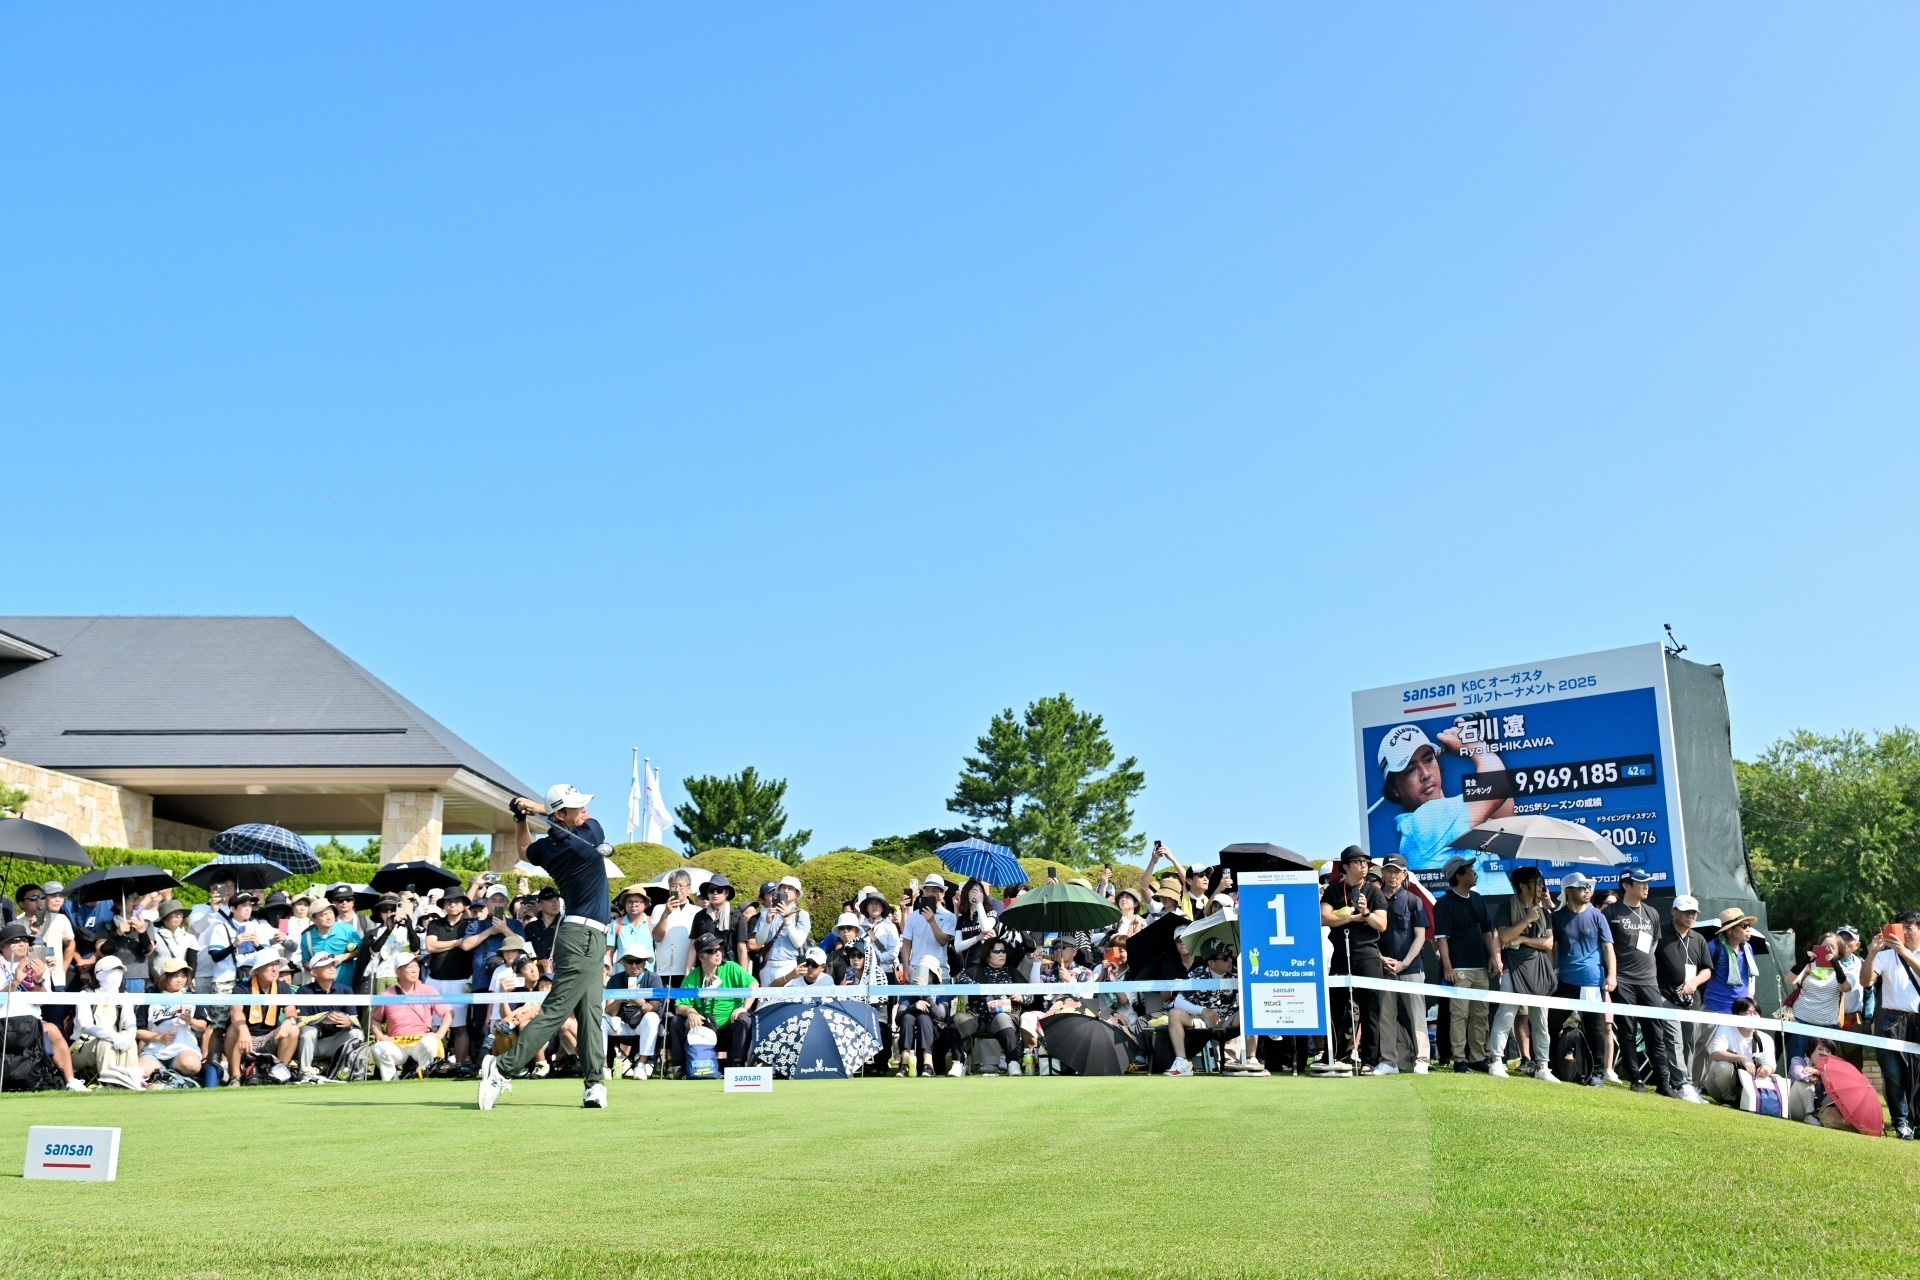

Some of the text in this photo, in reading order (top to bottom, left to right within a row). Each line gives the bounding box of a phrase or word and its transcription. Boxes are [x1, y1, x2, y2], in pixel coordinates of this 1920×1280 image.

[1461, 669, 1542, 692] KBC オーガスタ
[1462, 675, 1597, 705] ゴルフトーナメント 2025
[1403, 683, 1456, 703] sansan
[1389, 727, 1420, 747] Callaway
[1457, 714, 1526, 744] 石川 遼
[1460, 736, 1554, 757] Ryo ISHIKAWA
[1515, 762, 1646, 794] 9,969,185 42位
[1465, 786, 1492, 796] ランキング
[1513, 797, 1603, 814] 2025年シーズンの成績
[1597, 811, 1657, 823] ドライビングディスタンス
[1601, 826, 1657, 846] 300.76
[1267, 893, 1295, 945] 1
[1291, 957, 1315, 967] Par 4
[44, 1143, 94, 1157] sansan
